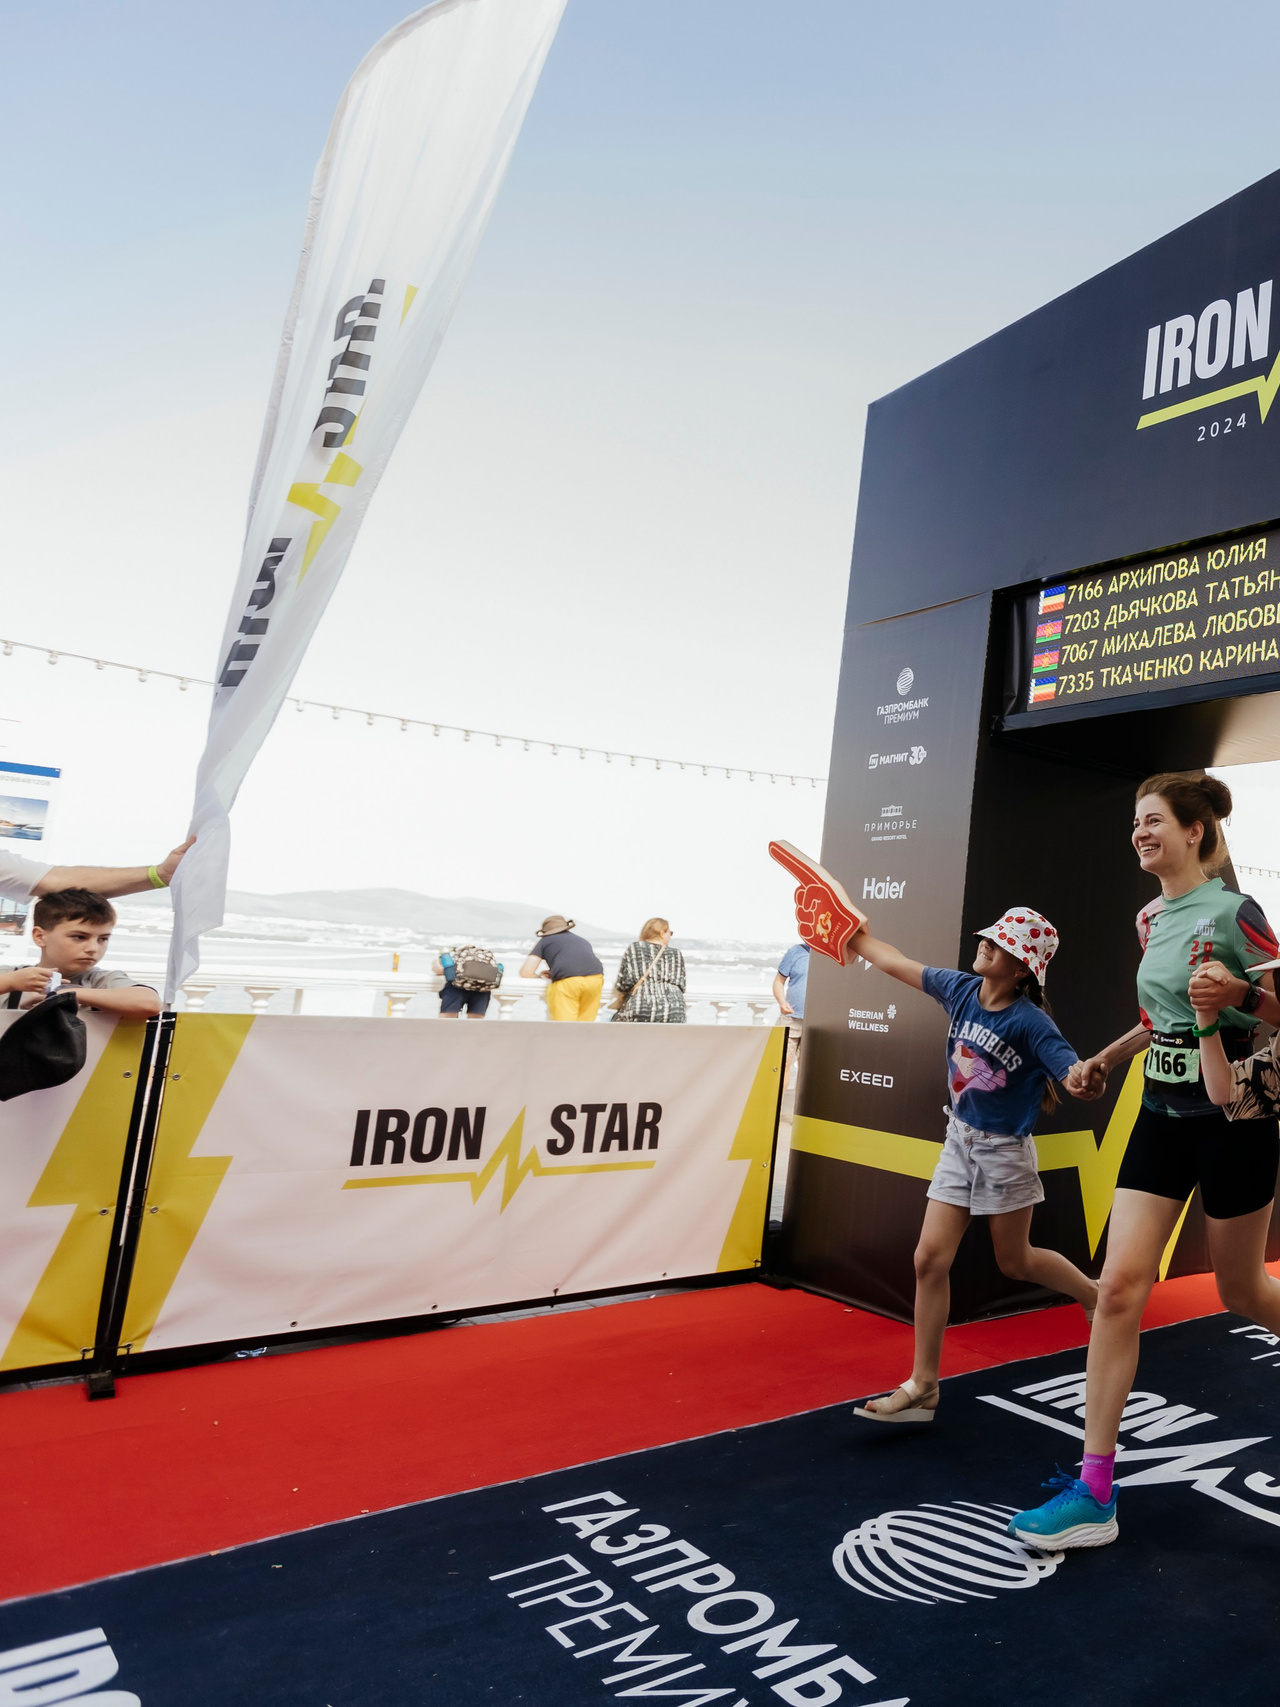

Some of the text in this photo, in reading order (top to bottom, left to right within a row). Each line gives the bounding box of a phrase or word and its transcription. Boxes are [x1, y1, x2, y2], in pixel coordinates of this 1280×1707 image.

[1142, 279, 1273, 400] IRON
[1196, 412, 1247, 442] 2024
[1067, 579, 1103, 604] 7166
[1108, 555, 1200, 595] АРХИПОВА
[1207, 537, 1267, 572] ЮЛИЯ
[1064, 609, 1100, 634] 7203
[1104, 588, 1198, 631] ДЬЯЧКОВА
[1061, 640, 1098, 664] 7067
[1102, 621, 1196, 657] МИХАЛЕВА
[1058, 671, 1094, 695] 7335
[1100, 653, 1193, 687] ТКАЧЕНКО
[1199, 638, 1279, 672] КАРИНА
[877, 697, 929, 716] ГАЗПРОМБАНК
[884, 710, 920, 725] ПРЕМИУМ
[879, 752, 909, 765] МАГНИТ
[865, 820, 917, 832] ПРИМОРЬЕ
[862, 876, 906, 899] Haier
[1193, 925, 1215, 937] LADY
[958, 1020, 1023, 1072] ANGELES
[840, 1069, 894, 1088] EXEED
[349, 1102, 662, 1167] IRON STAR
[541, 1491, 910, 1707] ГАЗПРОМБ
